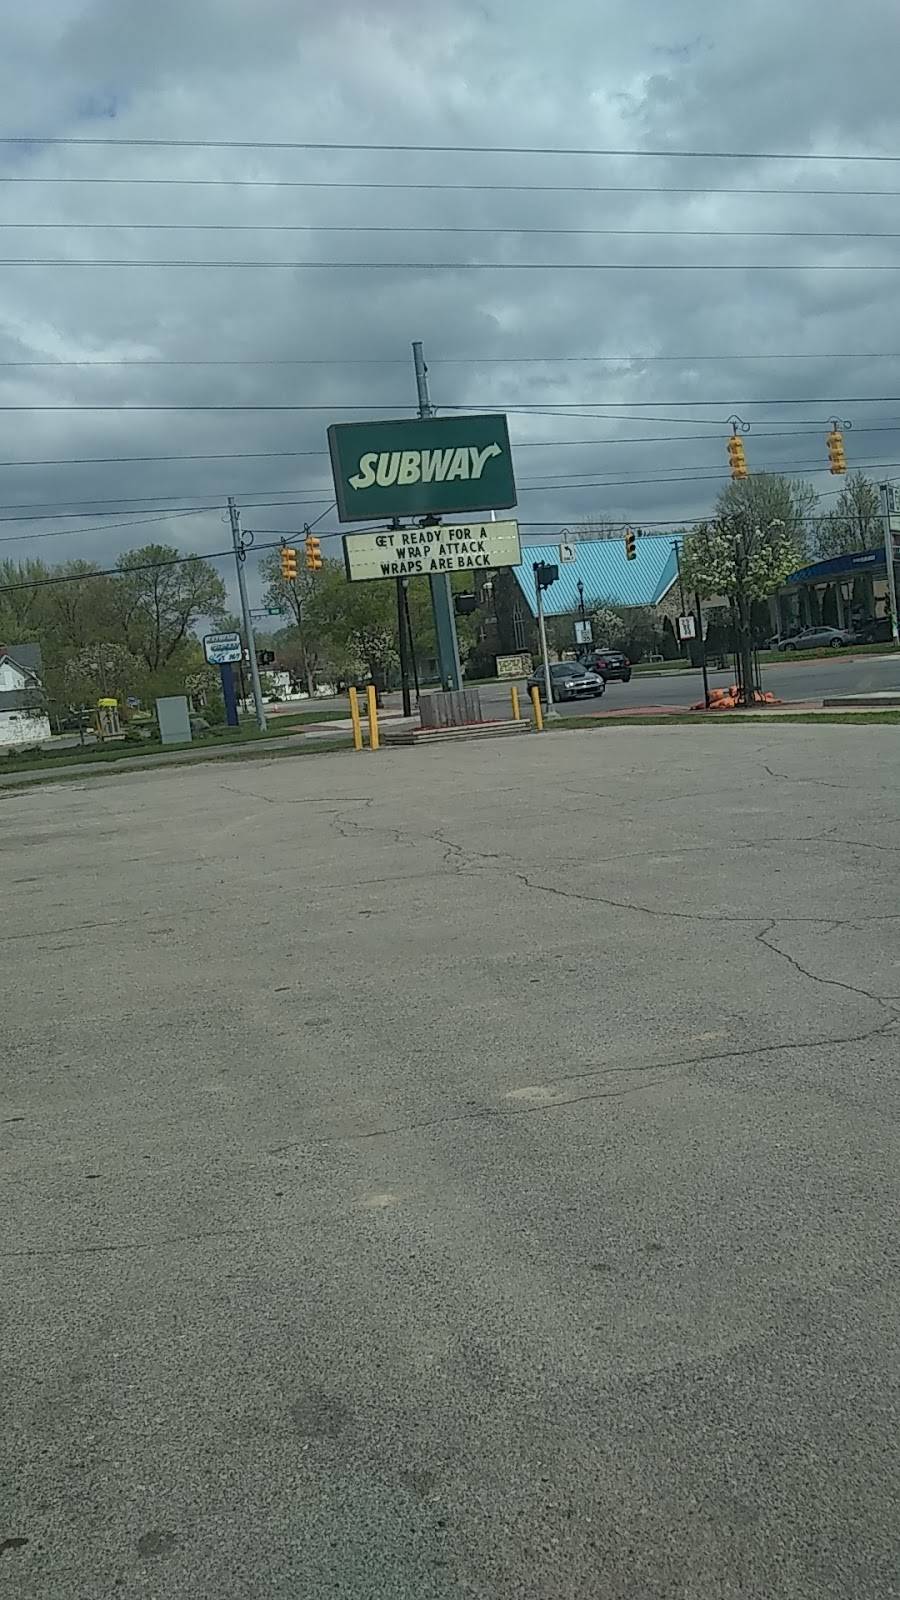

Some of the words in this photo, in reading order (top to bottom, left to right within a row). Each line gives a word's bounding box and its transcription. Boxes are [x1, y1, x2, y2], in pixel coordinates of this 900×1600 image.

[349, 442, 502, 490] SUBWAY
[375, 535, 395, 547] GET
[402, 530, 442, 545] READY
[449, 528, 471, 541] FOR
[479, 527, 488, 538] A
[396, 545, 431, 559] WRAP
[439, 541, 486, 555] ATTACK
[380, 561, 423, 576] WRAPS
[430, 558, 453, 571] ARE
[458, 554, 491, 568] BACK
